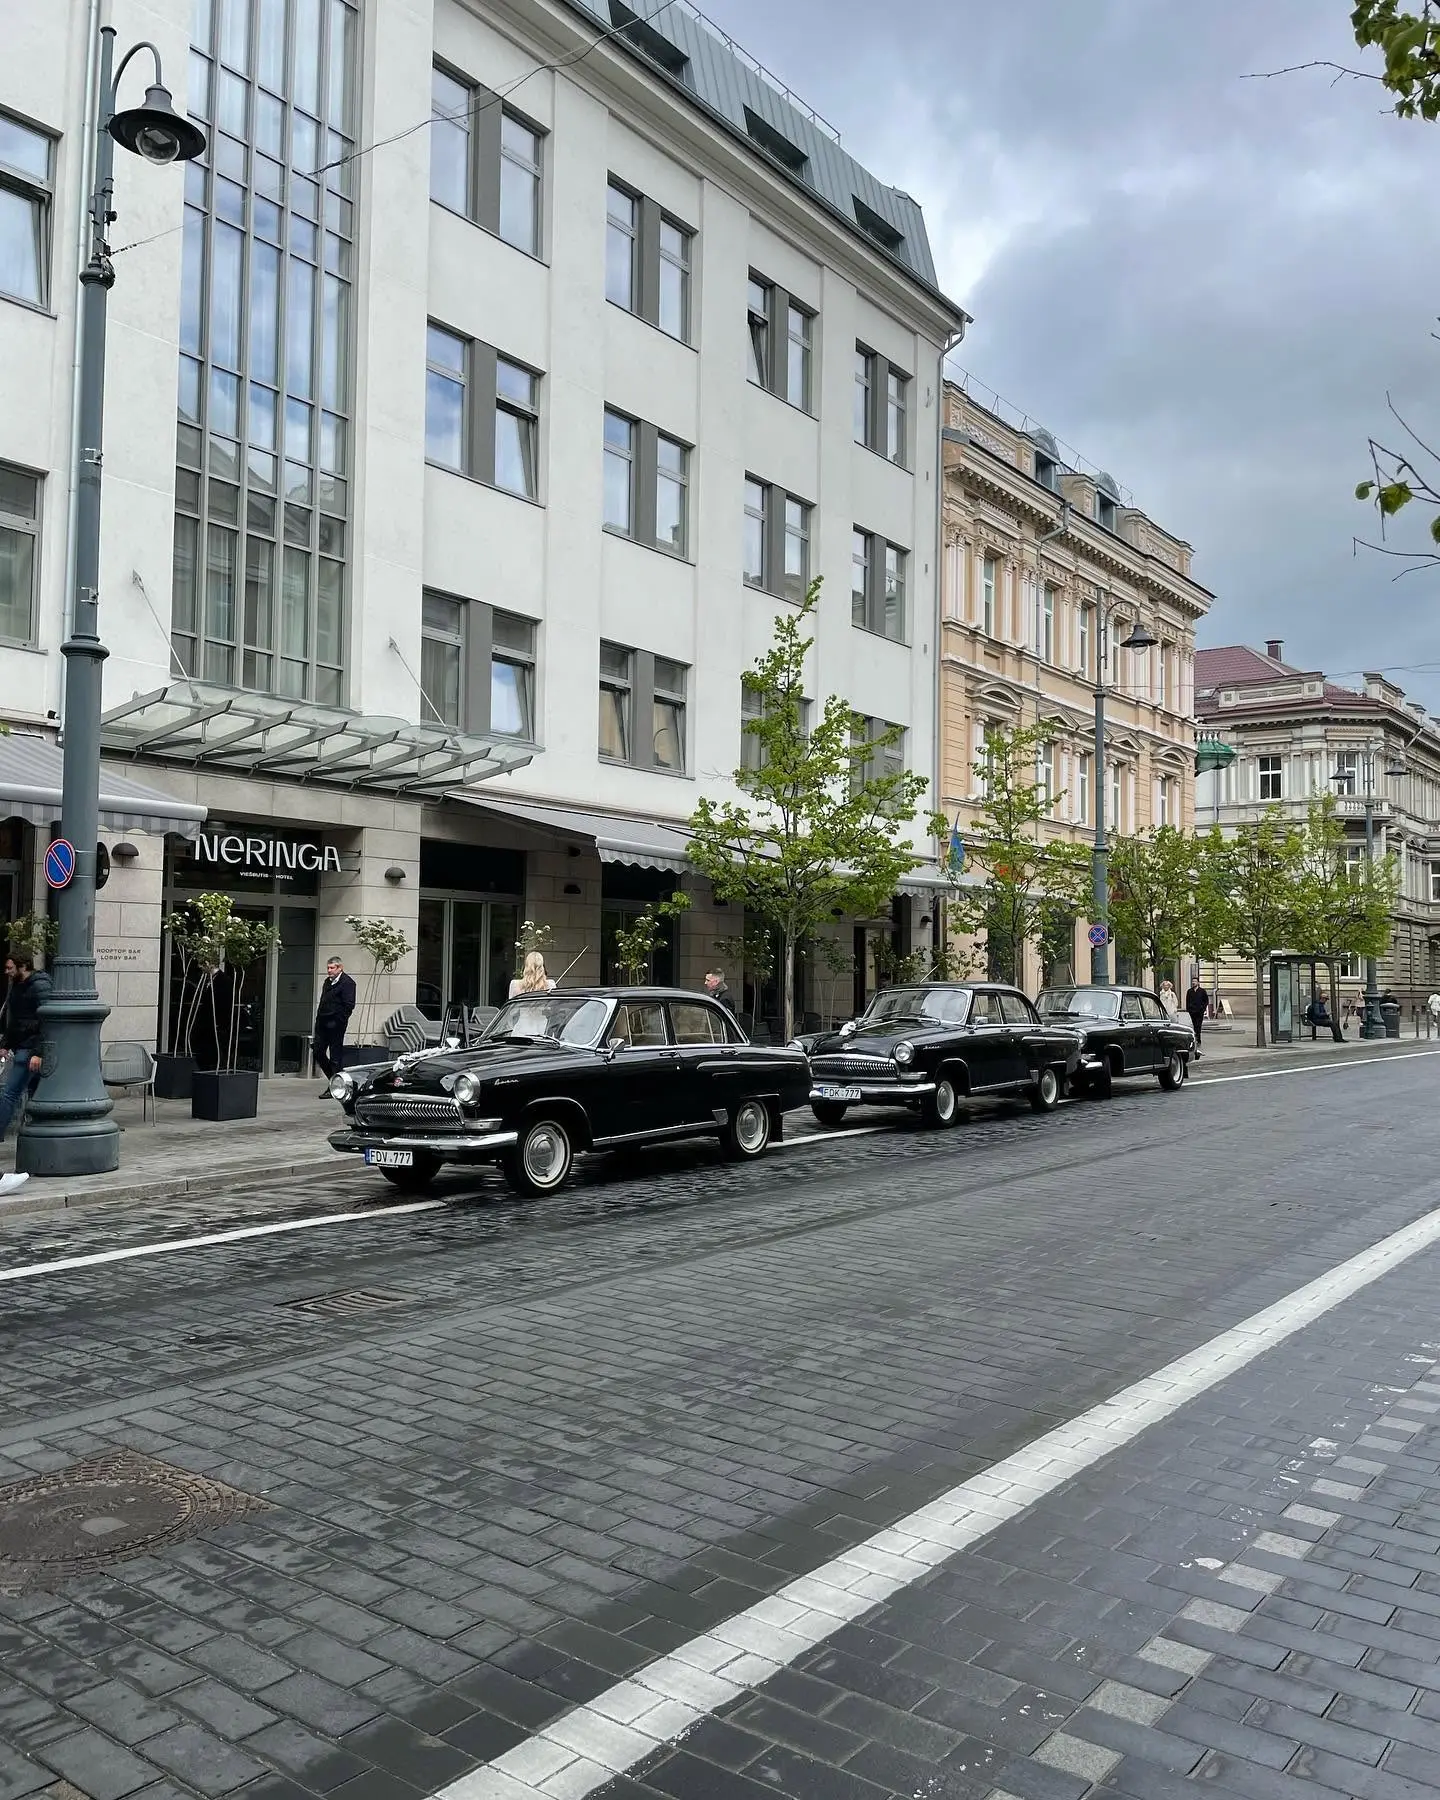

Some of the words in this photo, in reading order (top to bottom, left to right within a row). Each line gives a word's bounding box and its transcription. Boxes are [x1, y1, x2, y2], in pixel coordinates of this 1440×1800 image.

[823, 1088, 840, 1097] FDK
[845, 1089, 860, 1098] 777
[370, 1150, 388, 1163] FDV
[393, 1152, 411, 1164] 777
